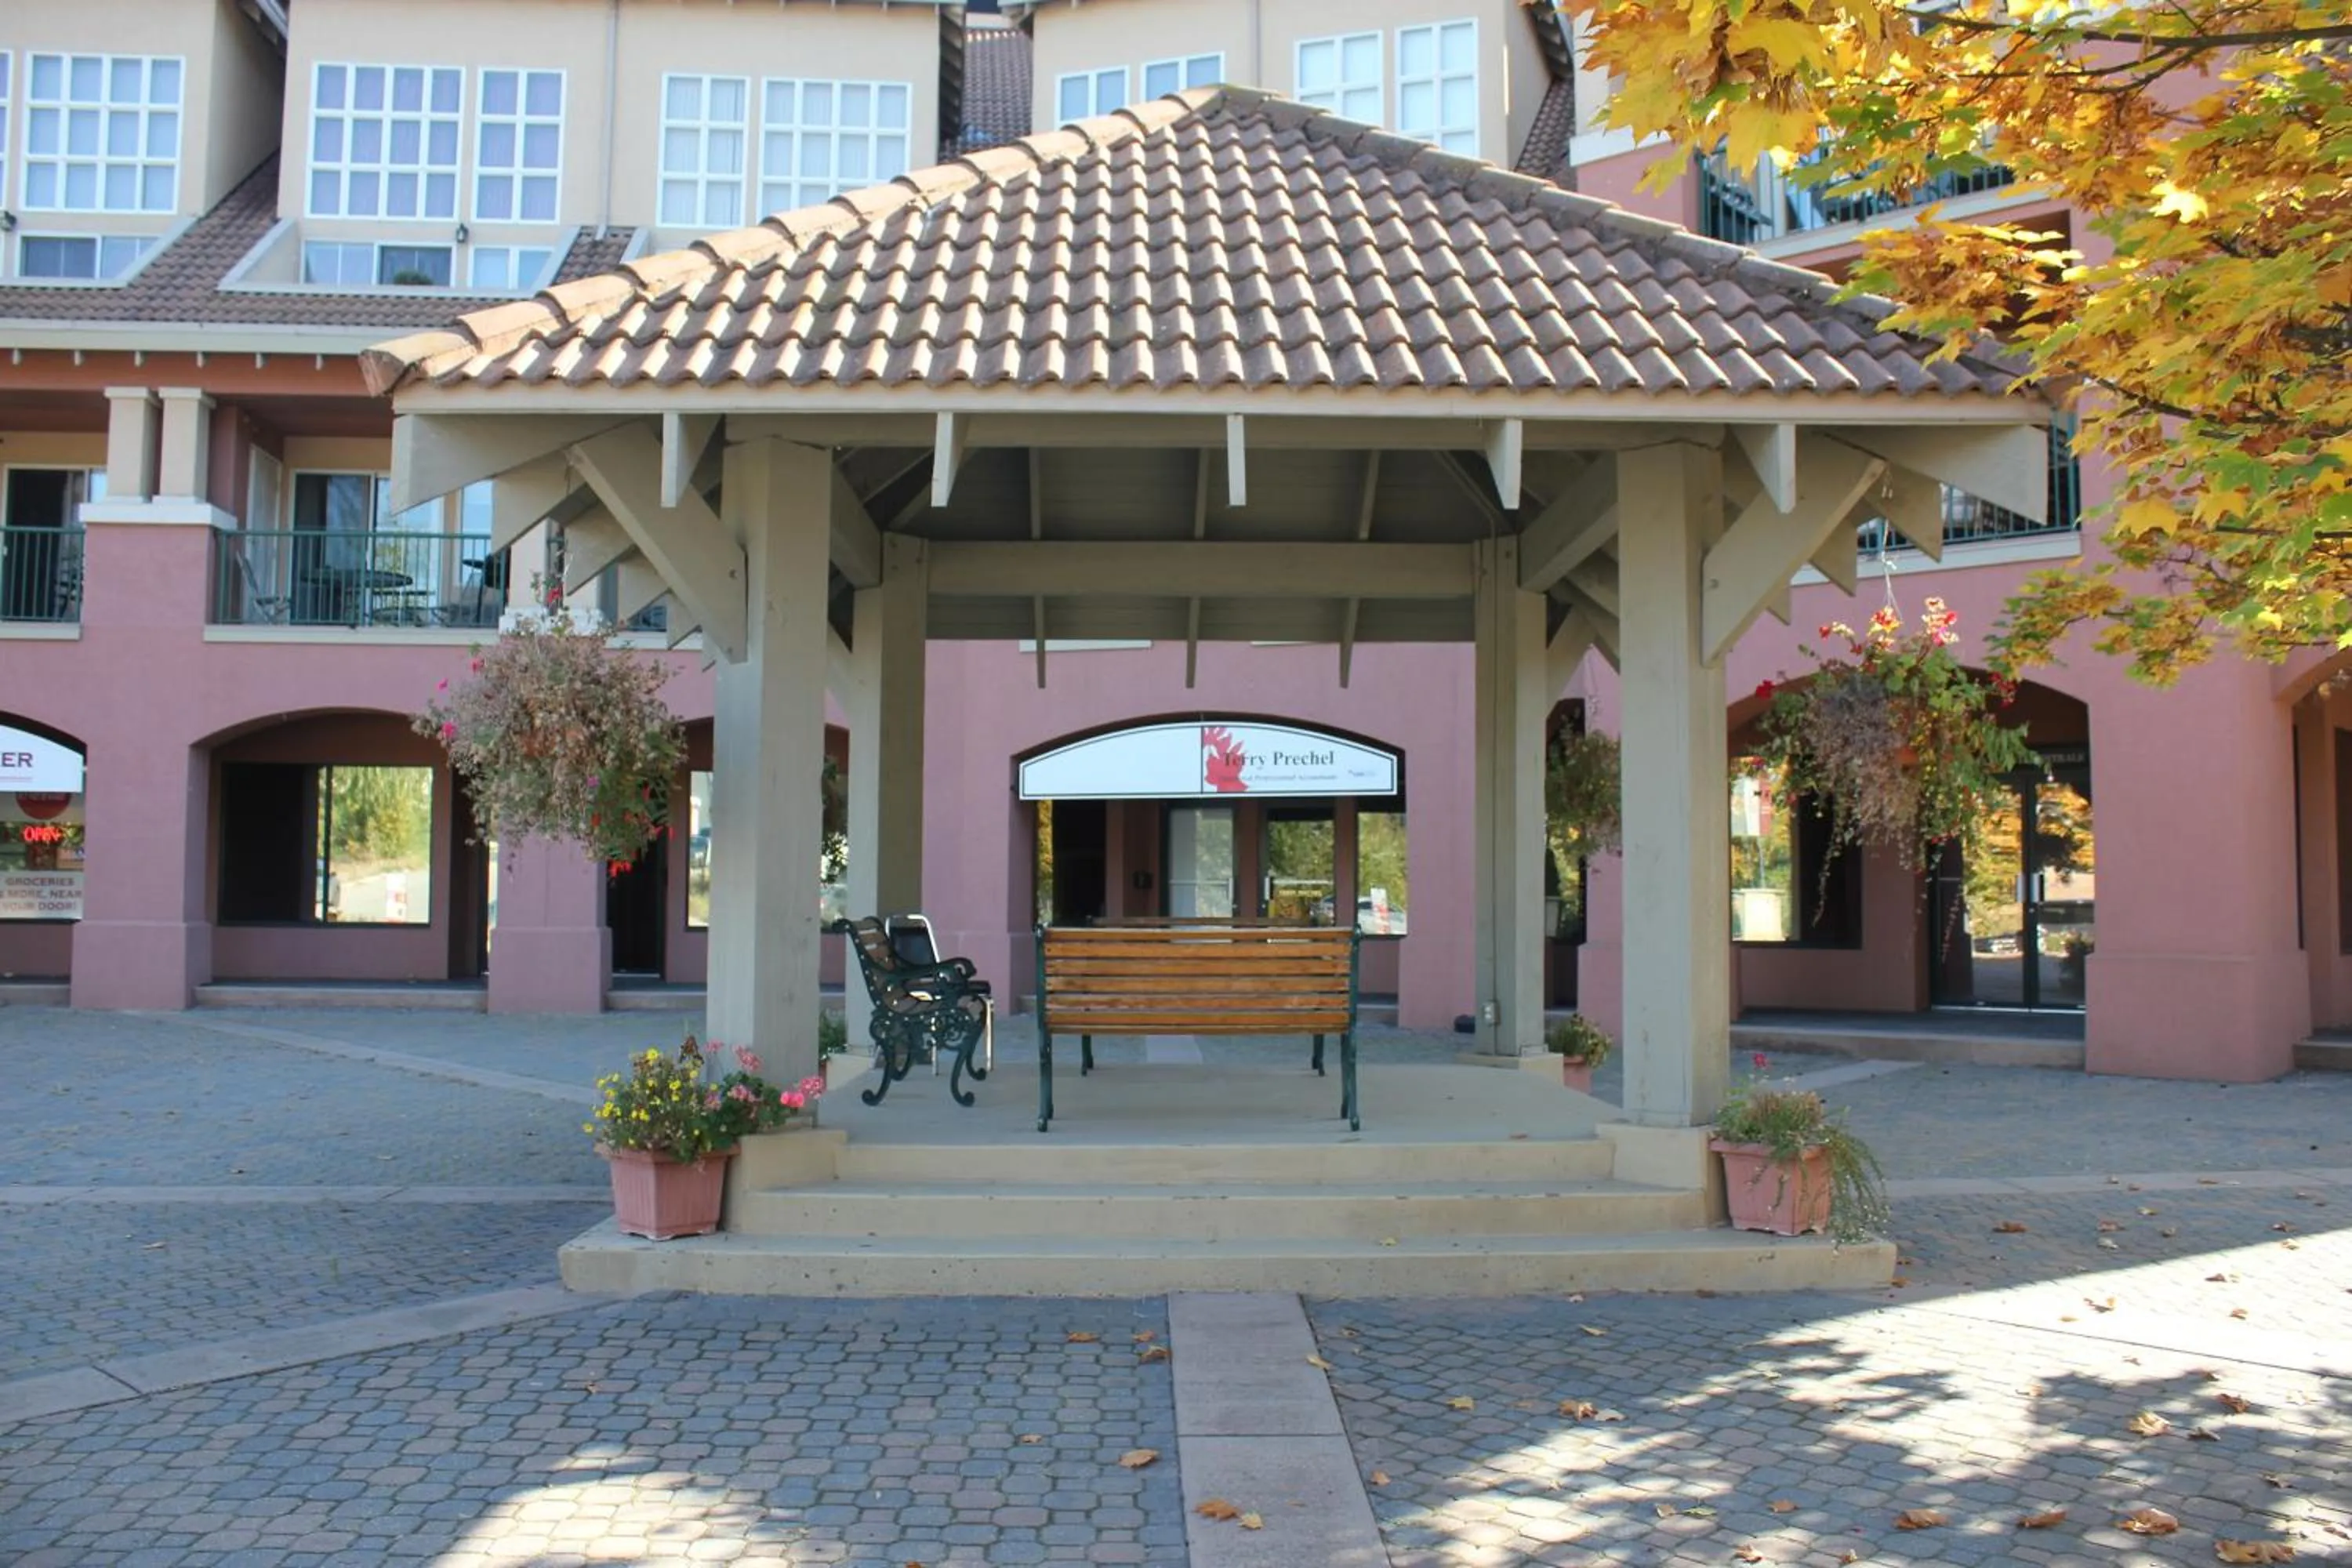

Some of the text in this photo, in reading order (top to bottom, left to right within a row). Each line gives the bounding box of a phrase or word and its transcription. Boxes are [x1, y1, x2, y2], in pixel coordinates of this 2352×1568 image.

[1225, 750, 1334, 771] Terry Prechel
[24, 826, 60, 841] OPEN
[6, 877, 74, 886] GROCERIES
[50, 890, 82, 898] NEAR
